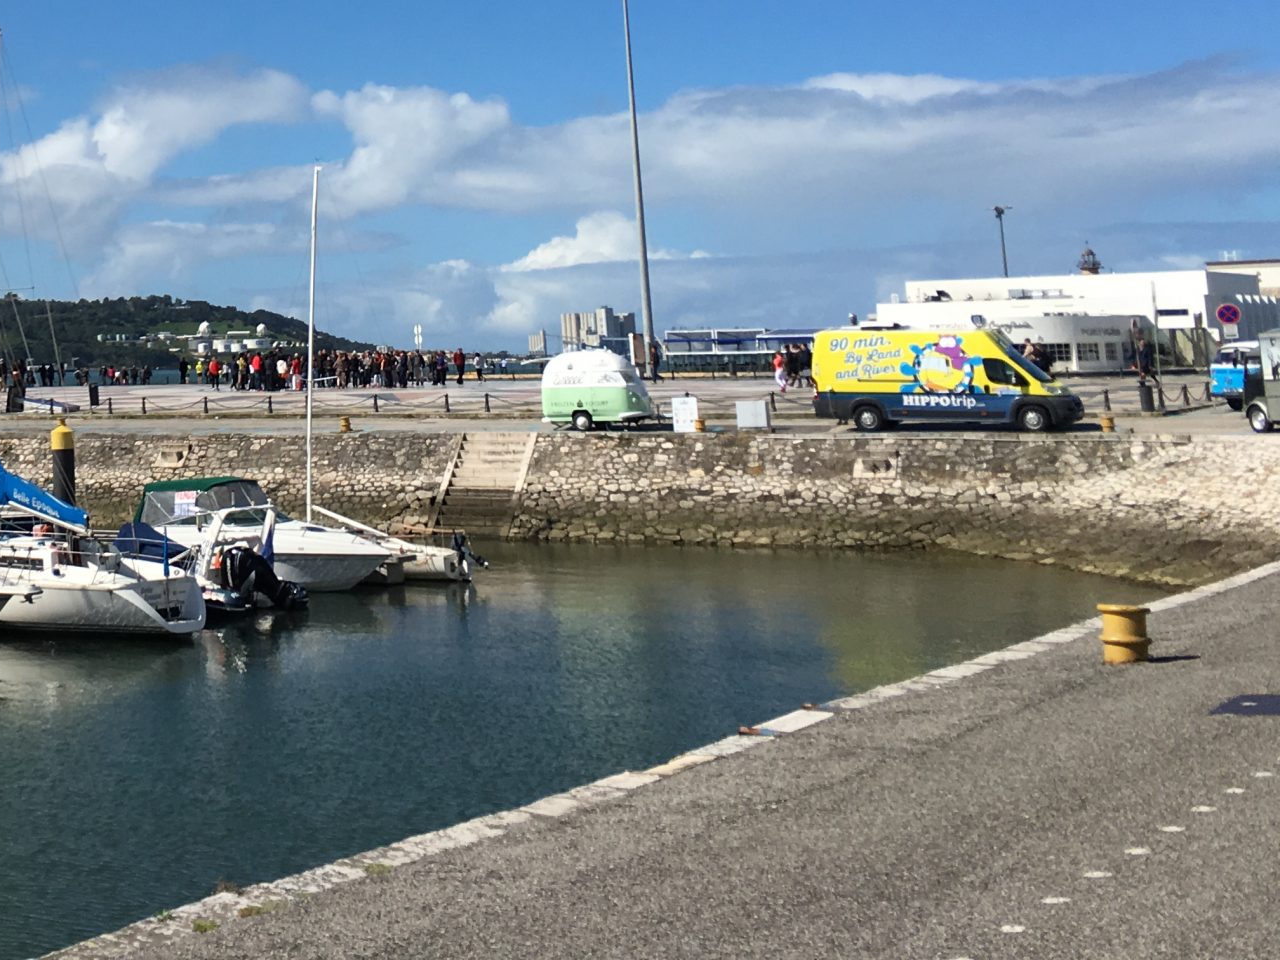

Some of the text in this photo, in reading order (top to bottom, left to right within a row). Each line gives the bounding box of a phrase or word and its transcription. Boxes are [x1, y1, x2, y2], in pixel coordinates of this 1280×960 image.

[829, 335, 891, 351] 90 min.
[844, 349, 901, 364] By Land
[835, 363, 896, 379] and River
